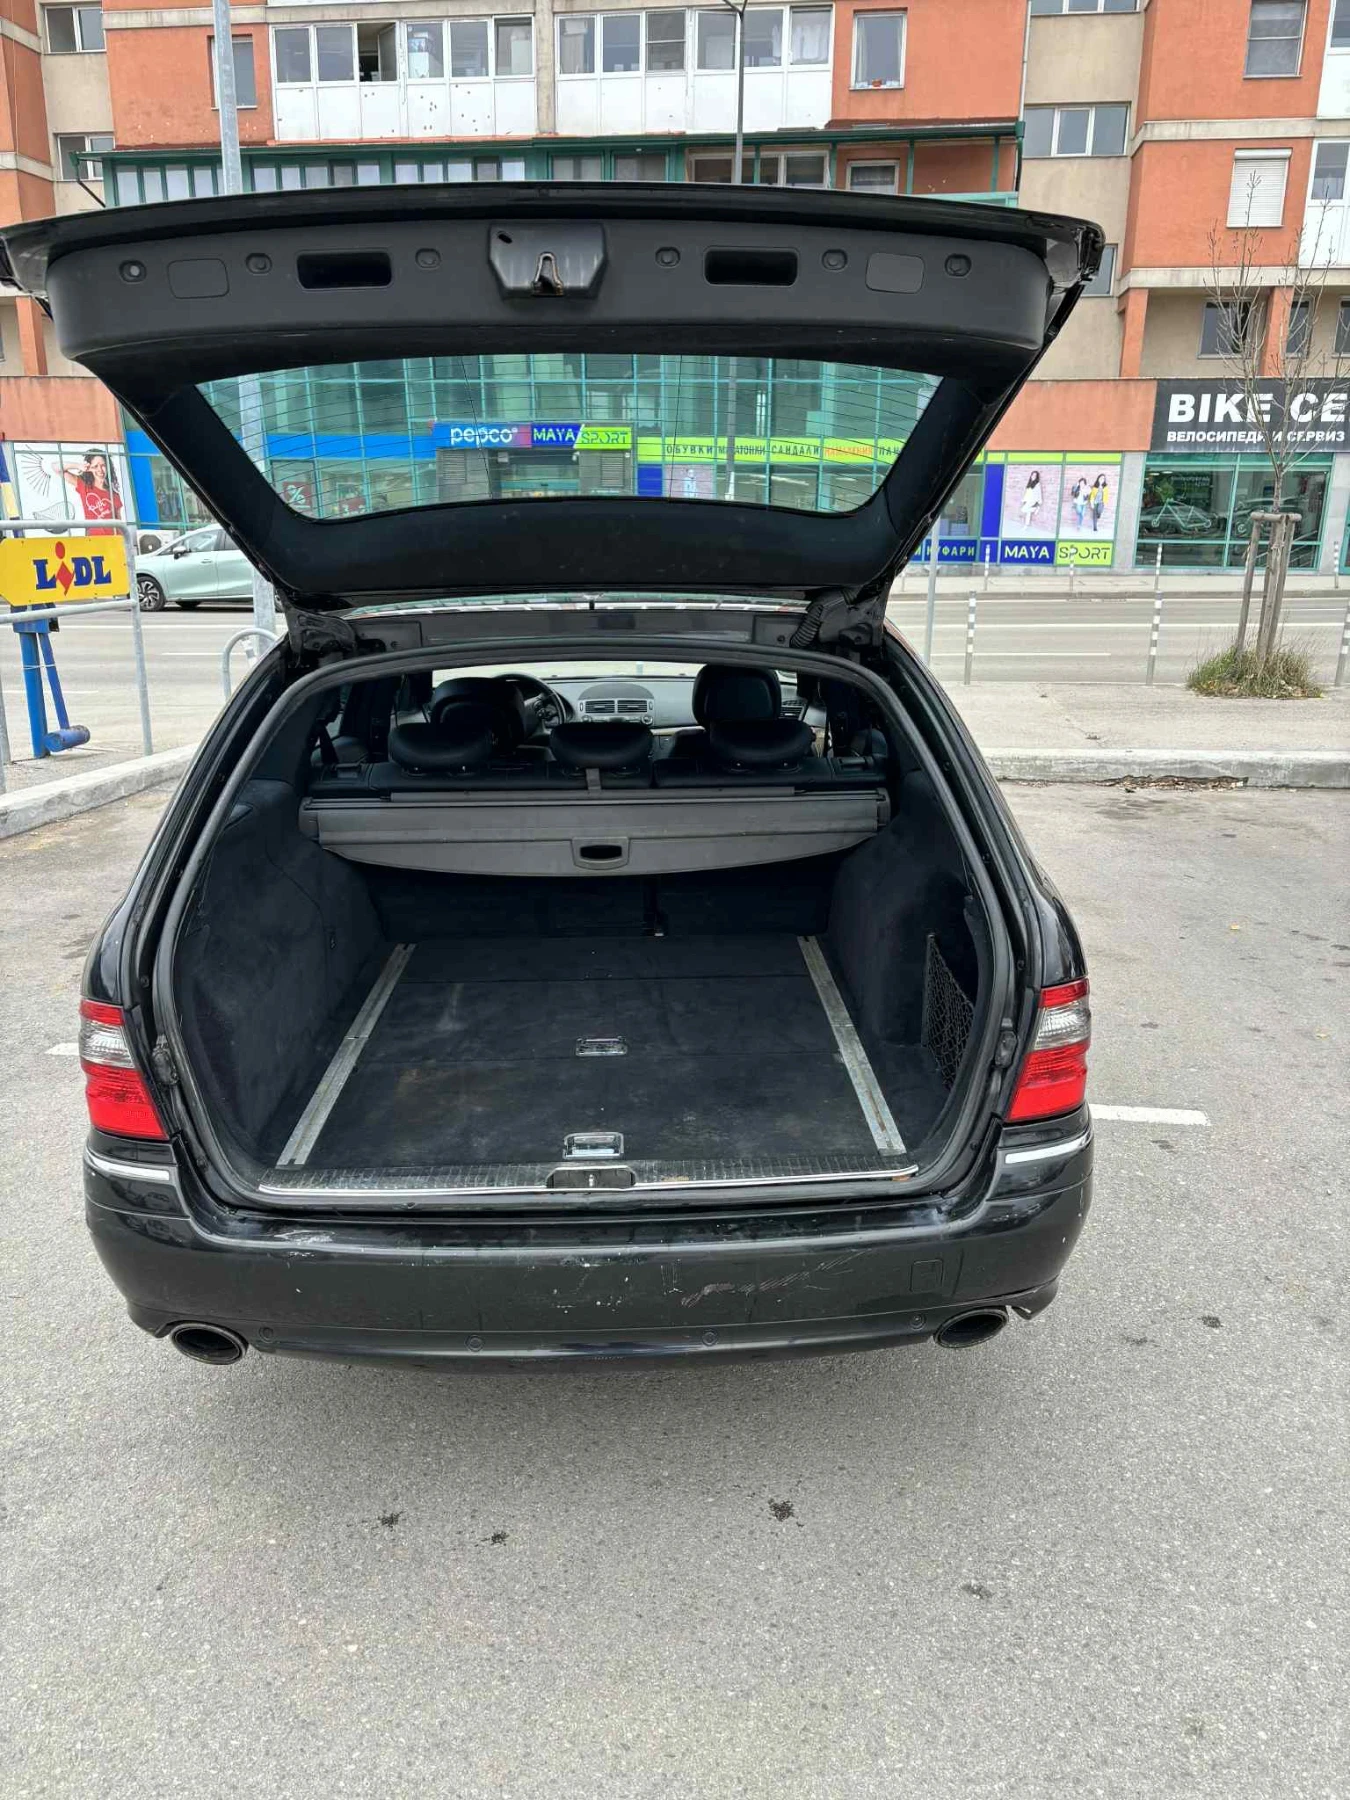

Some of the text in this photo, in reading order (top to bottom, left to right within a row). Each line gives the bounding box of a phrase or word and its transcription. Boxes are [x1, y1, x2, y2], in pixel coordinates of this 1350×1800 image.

[1168, 393, 1350, 423] BIKE CE
[533, 428, 628, 445] MAYA SPORT
[1272, 430, 1283, 442] И
[1286, 430, 1346, 442] СЕРВИЗ
[666, 444, 713, 455] ОБУВКИ
[771, 444, 820, 456] САНДАЛИ
[1004, 545, 1111, 560] MAYA SPORT
